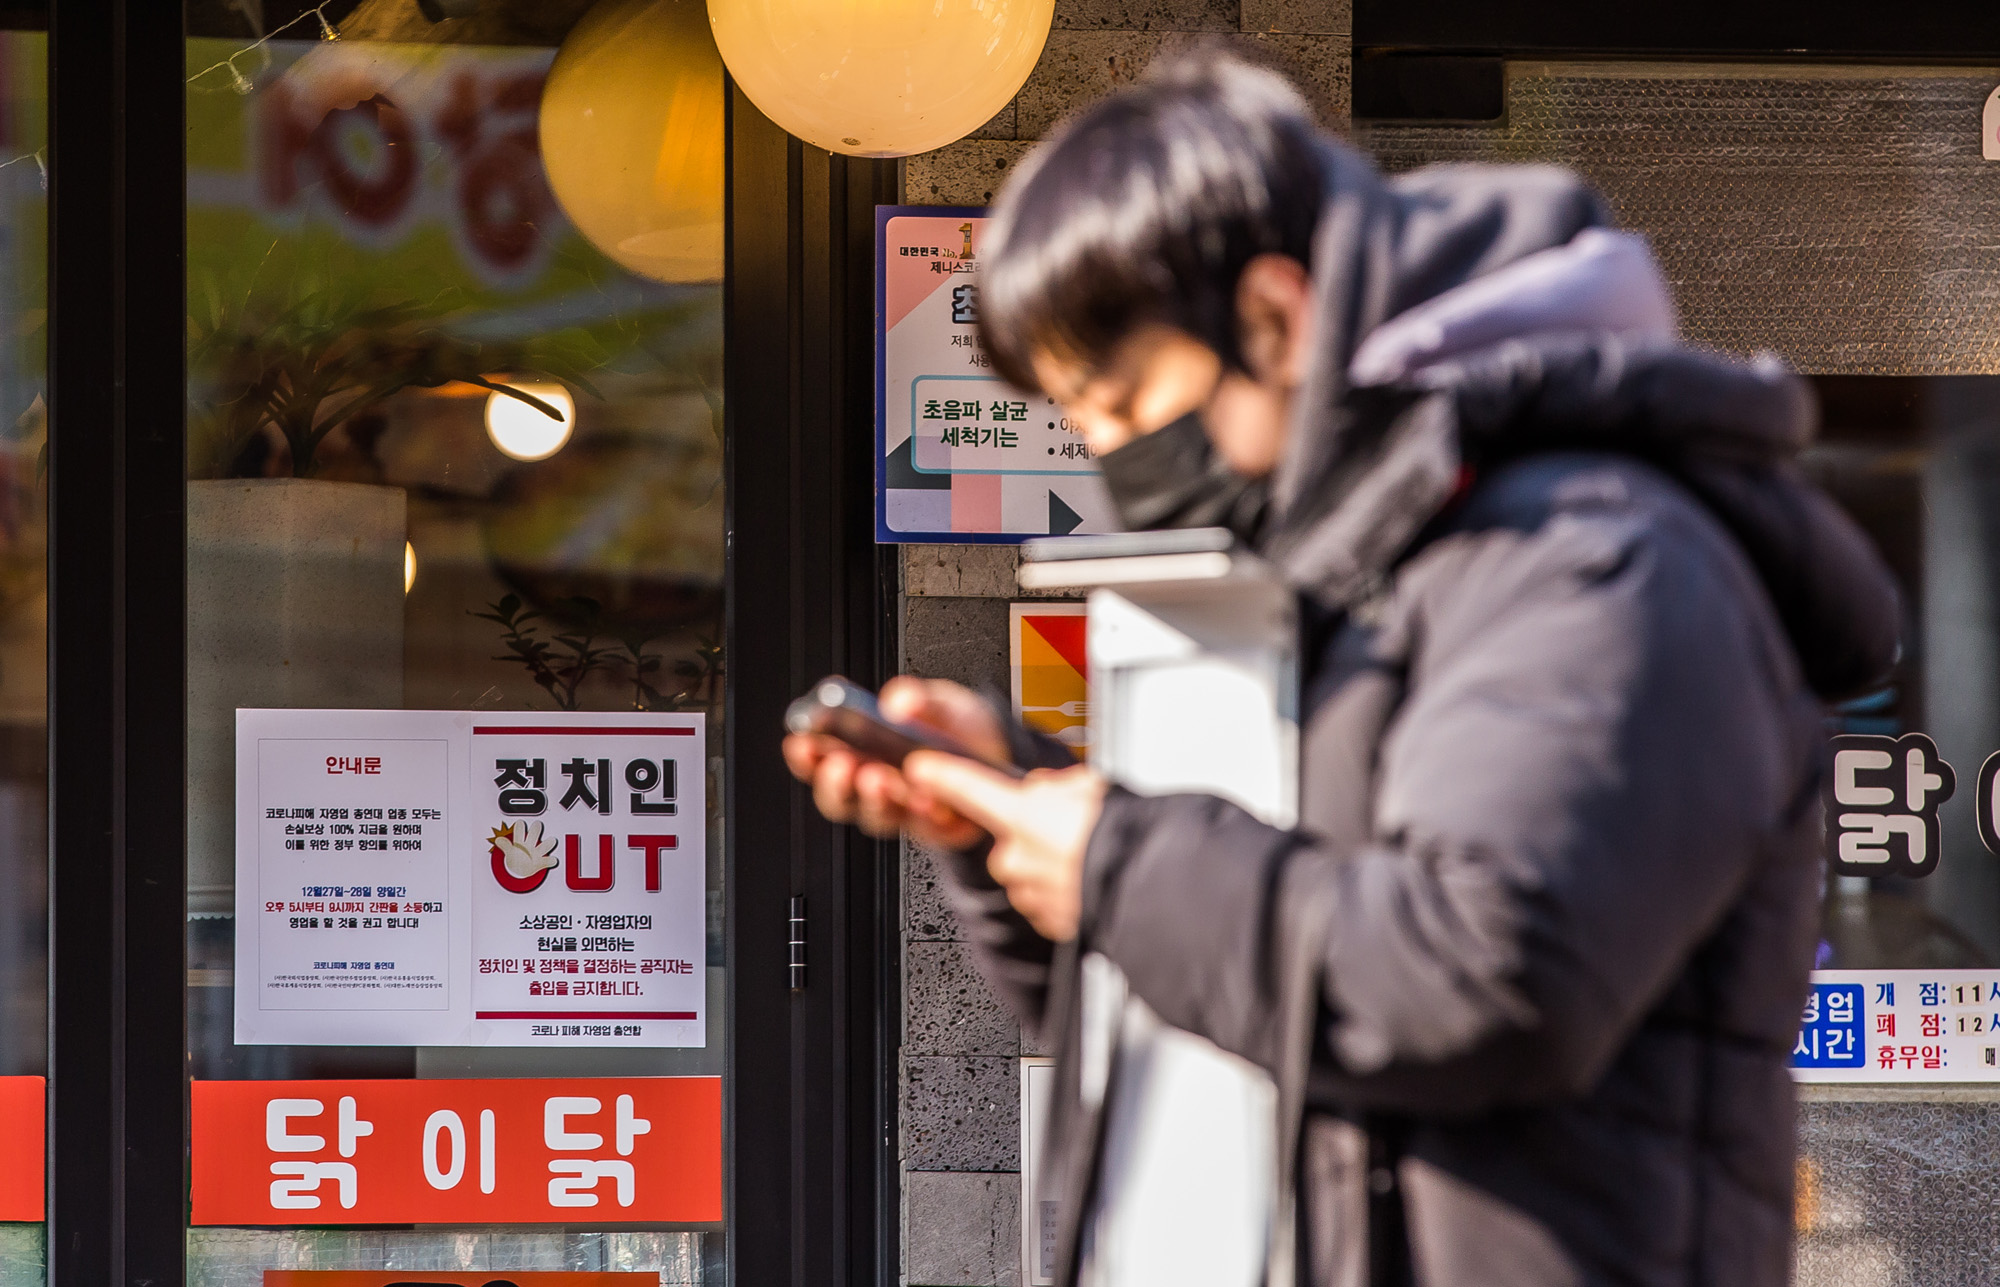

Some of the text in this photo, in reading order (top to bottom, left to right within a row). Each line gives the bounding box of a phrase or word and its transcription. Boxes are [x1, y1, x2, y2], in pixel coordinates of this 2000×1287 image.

[899, 246, 939, 257] 대한민국
[951, 334, 973, 348] 저희
[922, 400, 1028, 422] 초음파 살균
[940, 426, 1019, 449] 세척기는
[325, 756, 382, 775] 안내문
[494, 757, 678, 816] 정치인
[265, 808, 441, 820] 코로나피해 자영업 총연대 업종 모두는
[284, 824, 422, 835] 손실보상 100% 지급을 원하며
[285, 839, 422, 851] 이를 위한 정부 항의를 위하여
[301, 886, 406, 898] 12월27일~28일 양일간
[265, 902, 443, 913] 오후 5시부터 9시까지 간판을 소등하고
[289, 917, 319, 929] 영업을
[323, 917, 333, 929] 할
[337, 917, 358, 929] 것을
[362, 917, 382, 929] 권고
[519, 915, 652, 930] 소상공인 자영업자의
[537, 937, 635, 952] 현실을 외면하는
[313, 961, 395, 970] 코로나피해 자영업 총연대
[478, 959, 693, 975] 정치인 및 정책을 결정하는 공직자는
[528, 981, 644, 996] 출입을 금지합니다.
[531, 1024, 641, 1037] 코로나 피해 자영업 총연합
[1793, 1028, 1856, 1060] 시간
[1877, 1045, 1948, 1069] 휴무일:
